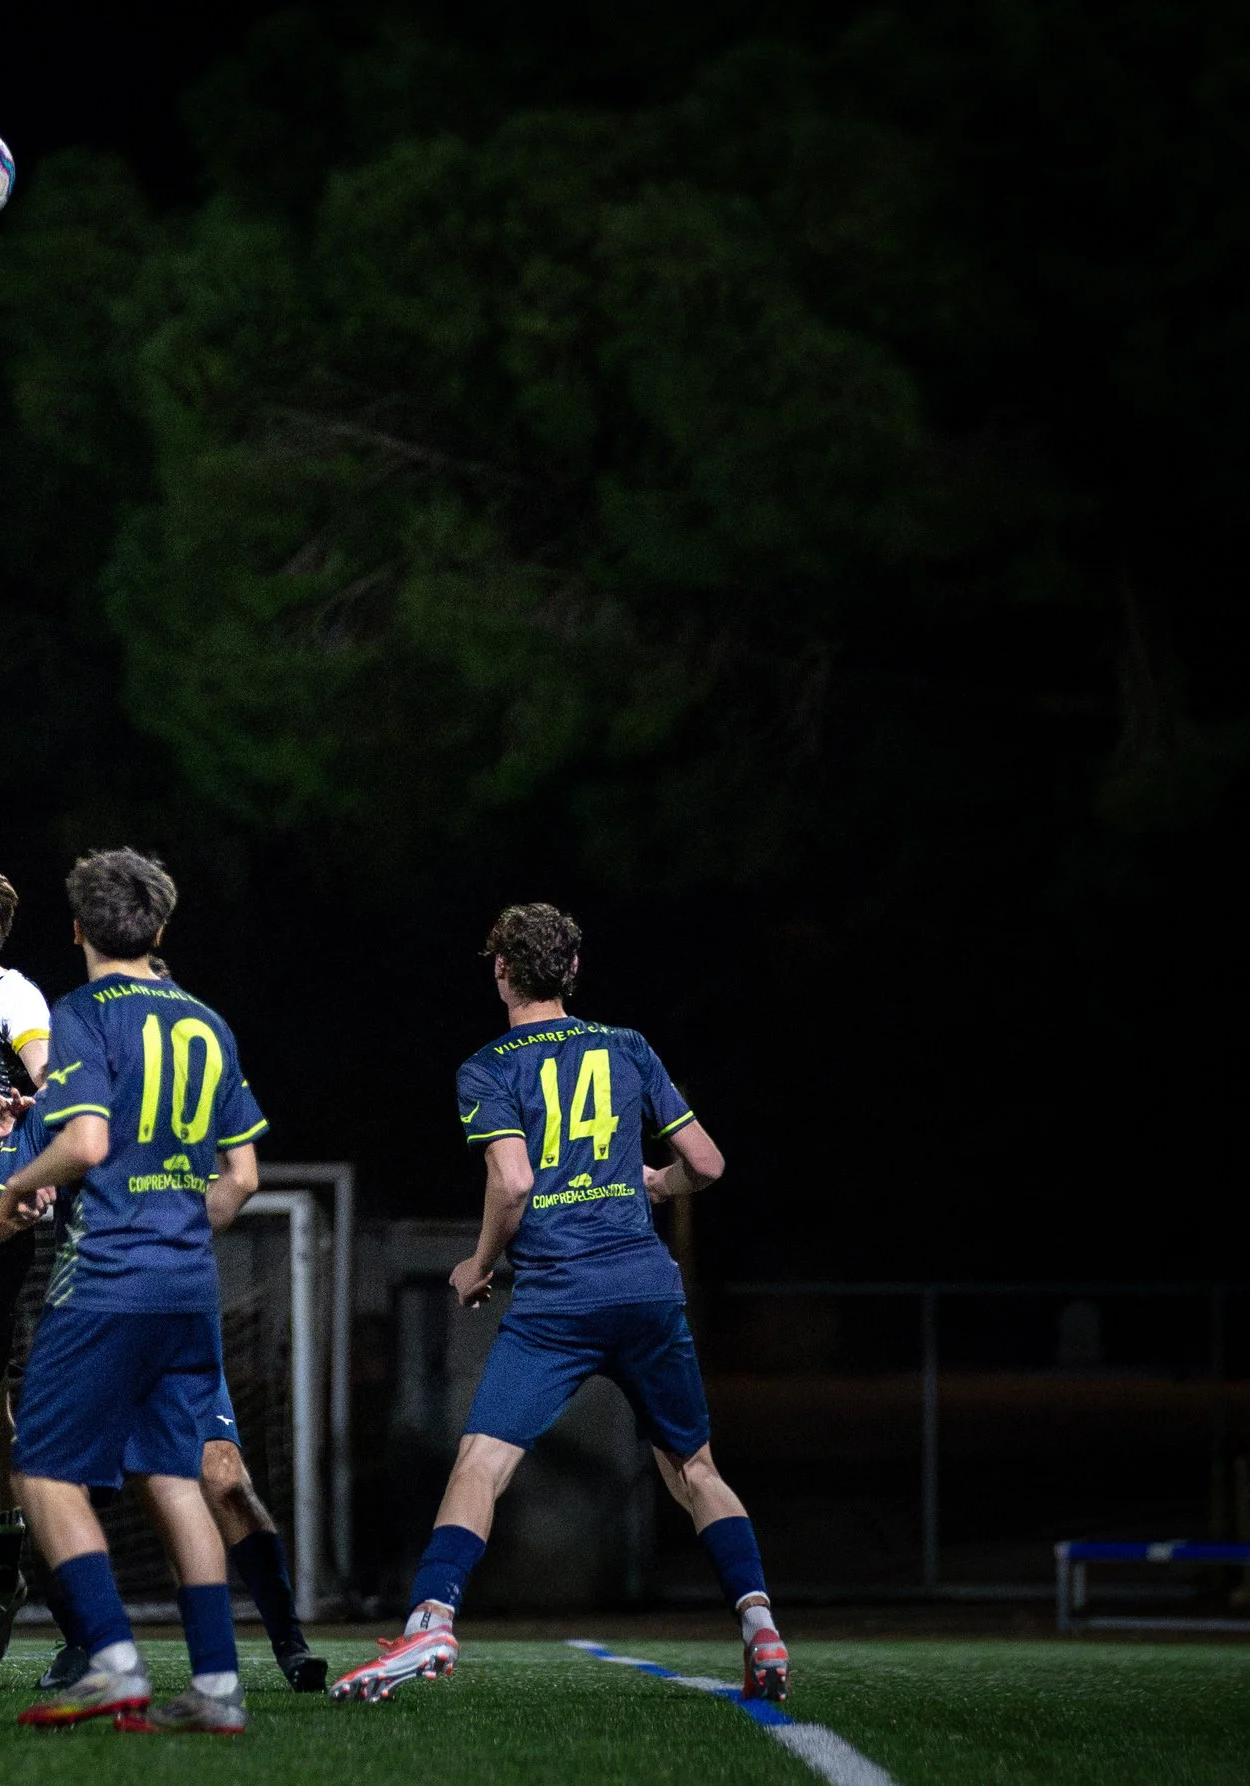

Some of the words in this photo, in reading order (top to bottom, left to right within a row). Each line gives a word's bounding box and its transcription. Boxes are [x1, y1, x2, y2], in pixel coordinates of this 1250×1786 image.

[138, 1013, 224, 1144] 10
[493, 1026, 584, 1055] VILLARREAL
[539, 1049, 619, 1169] 14
